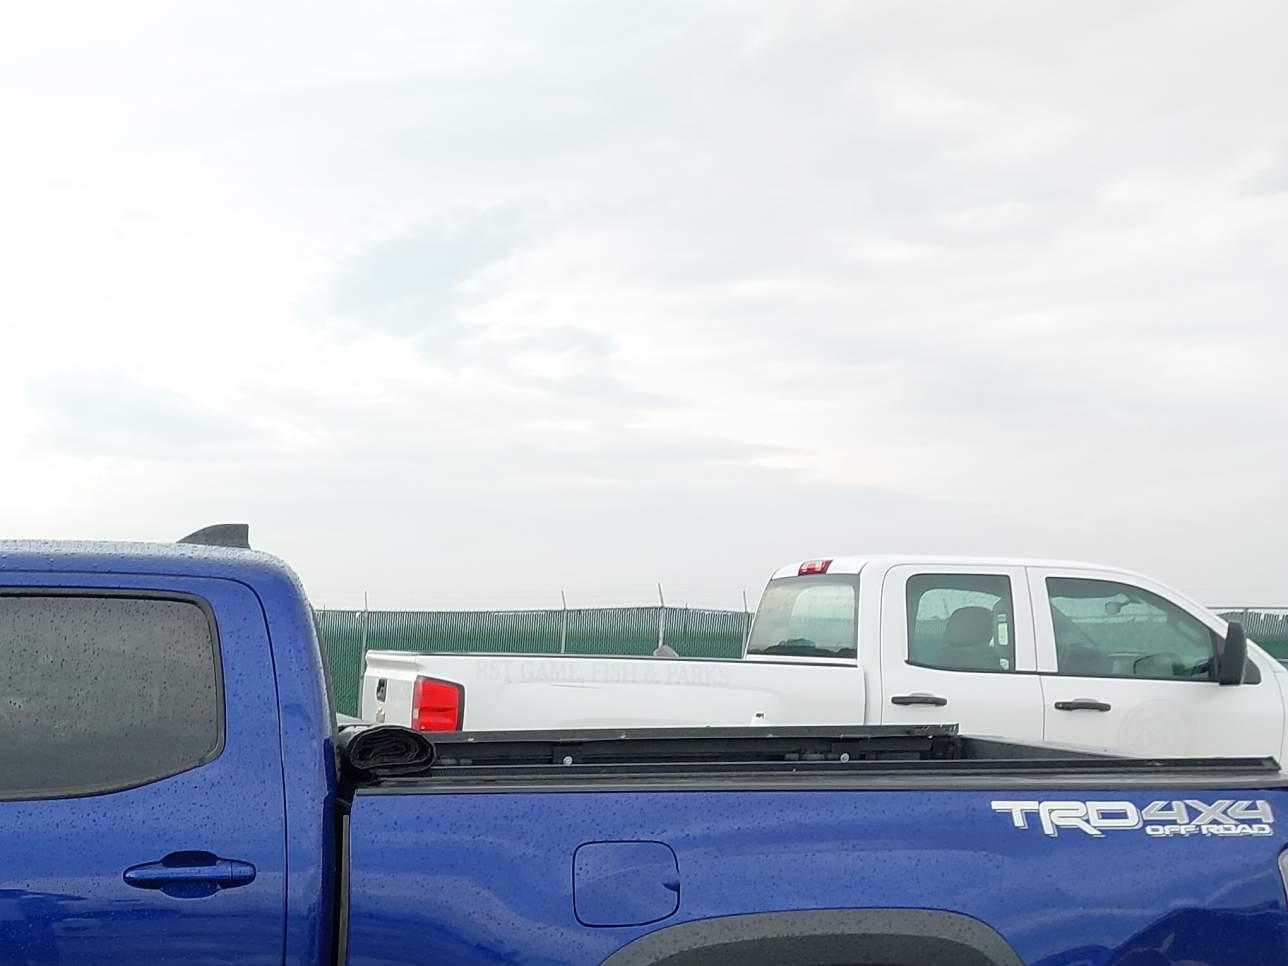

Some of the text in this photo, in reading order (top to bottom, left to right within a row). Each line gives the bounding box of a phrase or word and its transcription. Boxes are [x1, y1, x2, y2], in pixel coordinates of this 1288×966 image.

[990, 800, 1143, 838] TRD
[1144, 824, 1274, 837] OFF ROAD
